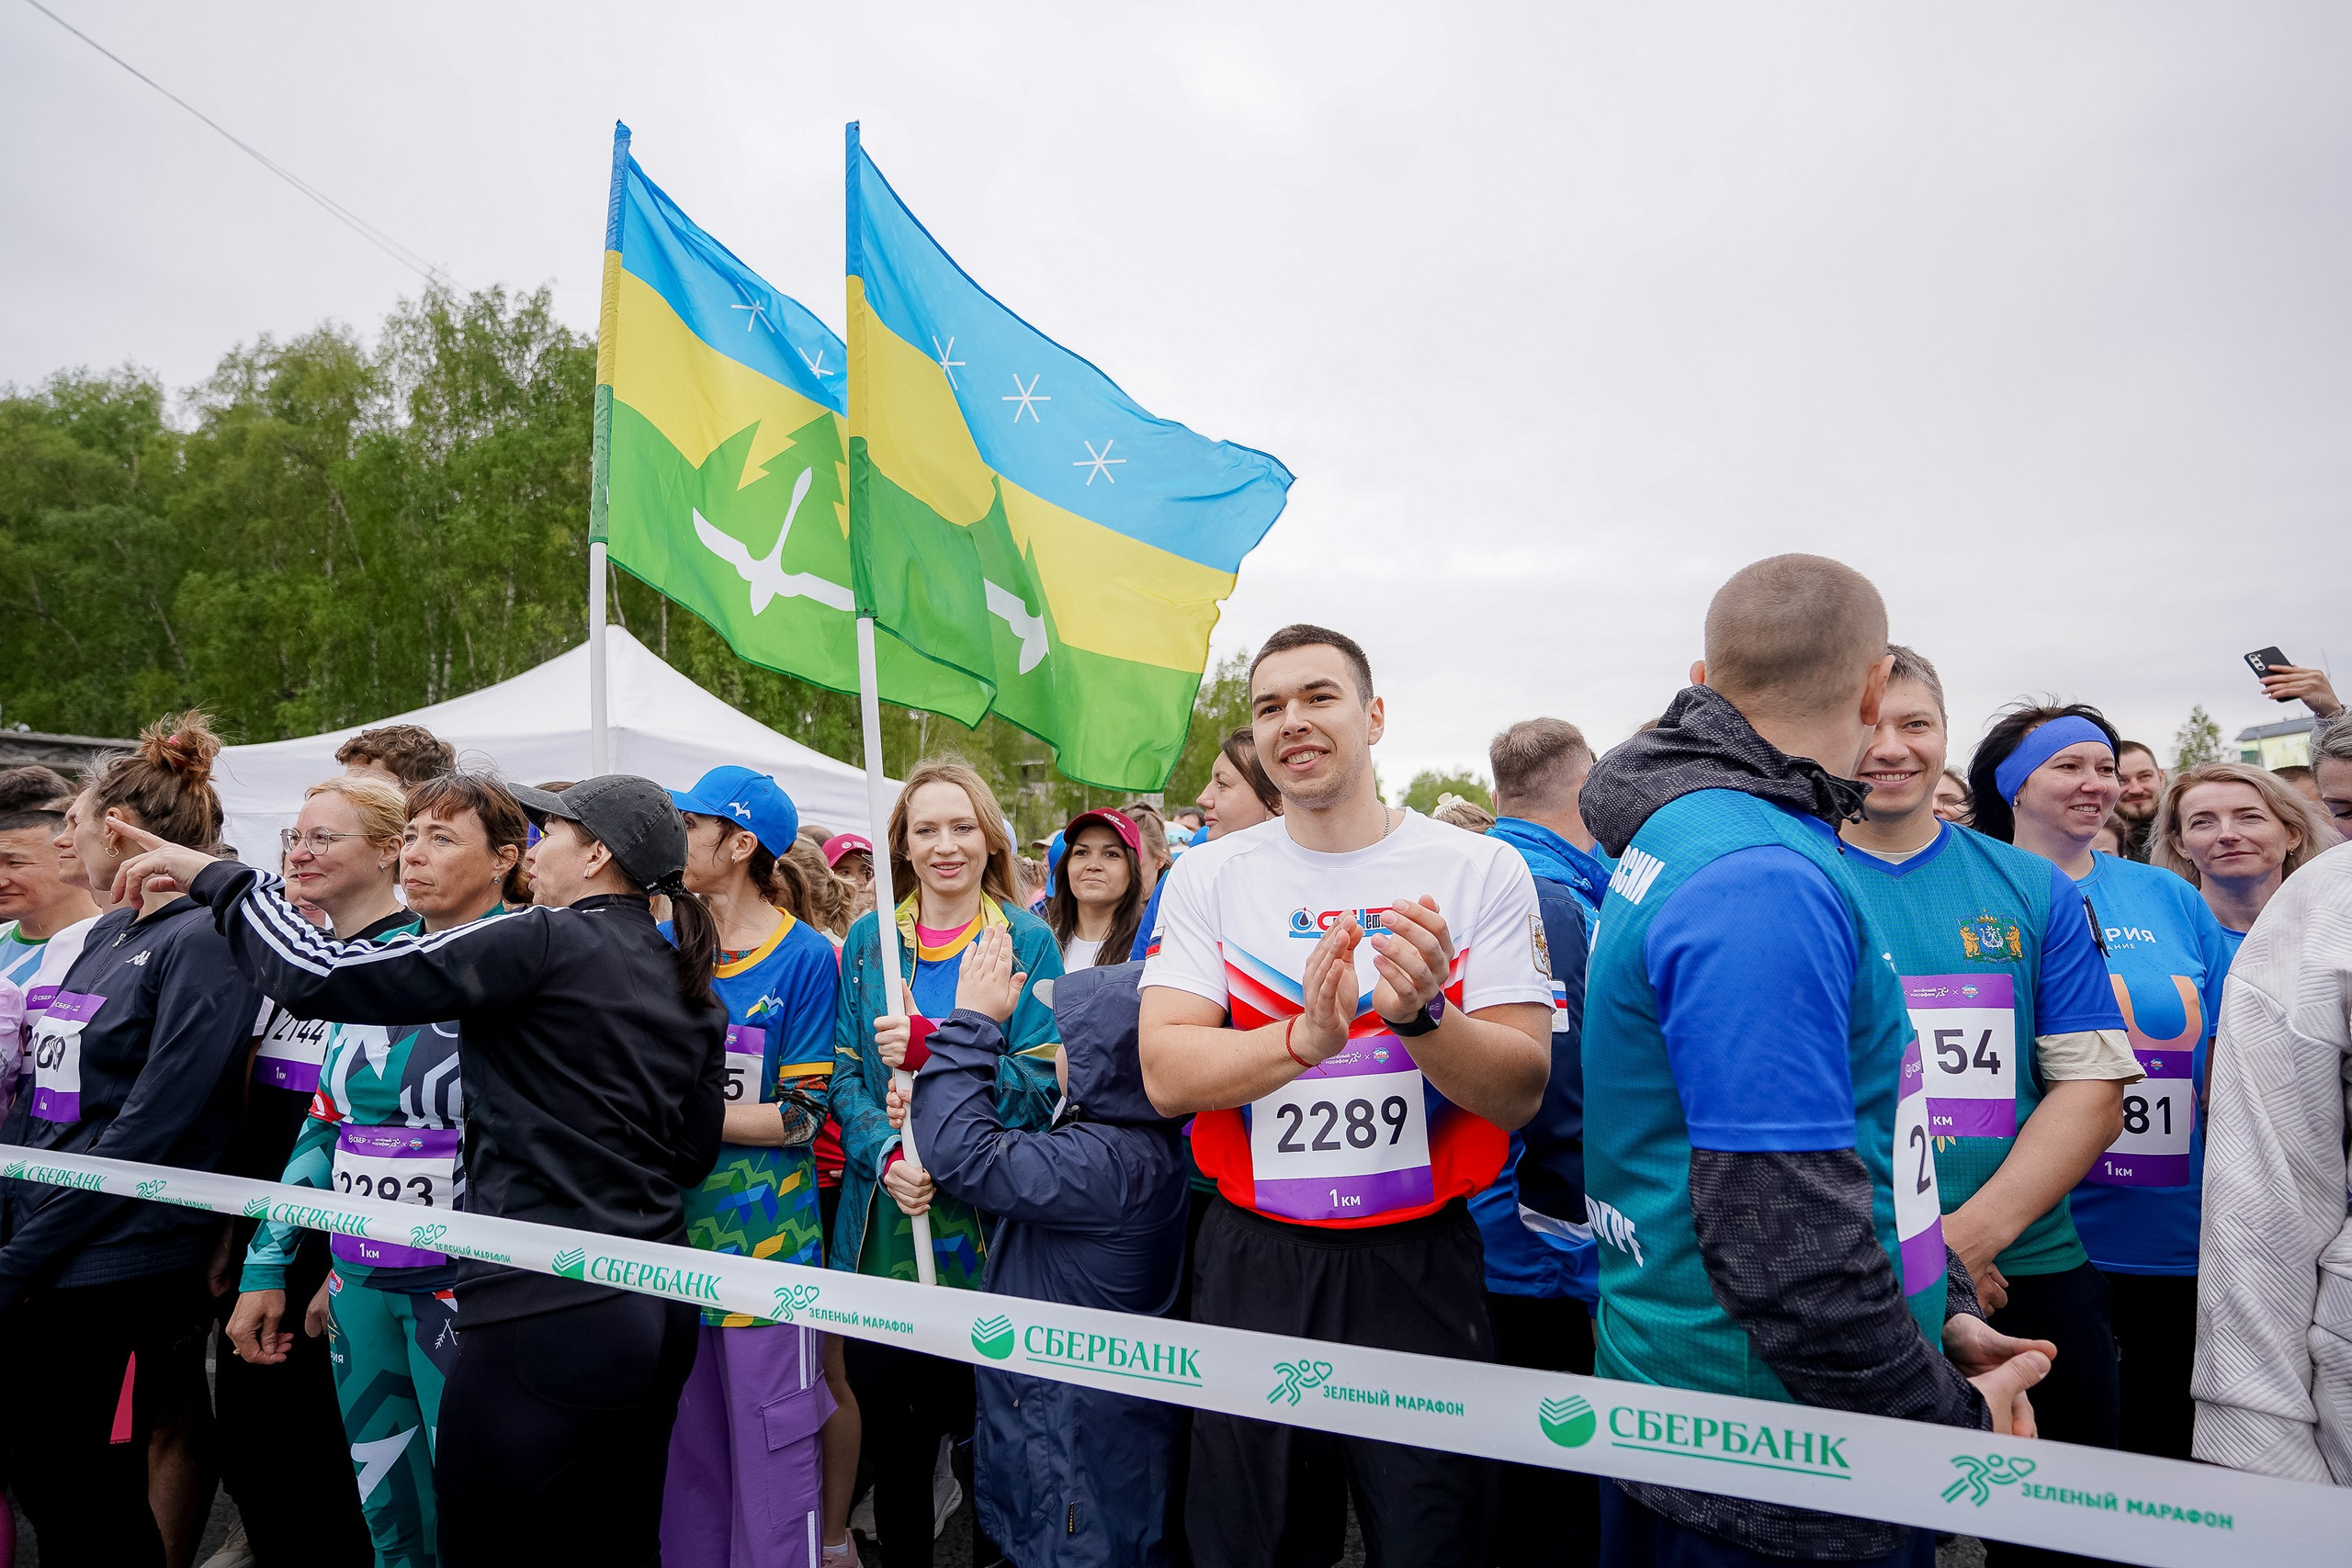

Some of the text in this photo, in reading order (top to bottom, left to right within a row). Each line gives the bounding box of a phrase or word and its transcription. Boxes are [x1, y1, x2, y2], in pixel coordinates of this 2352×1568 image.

[1915, 1029, 2002, 1075] 54
[1276, 1095, 1408, 1154] 2289
[27, 1166, 108, 1192] СБЕРБАНК
[272, 1202, 374, 1238] СБЕРБАНК
[591, 1256, 723, 1302] СБЕРБАНК
[808, 1307, 914, 1335] ЗЕЛЕНЫЙ МАРАФОН
[1024, 1325, 1203, 1379] СБЕРБАНК
[1323, 1385, 1464, 1416] ЗЕЛЕНЫЙ МАРАФОН
[1609, 1405, 1851, 1470] СБЕРБАНК
[2021, 1482, 2234, 1531] ЗЕЛЕНЫЙ МАРАФОН
